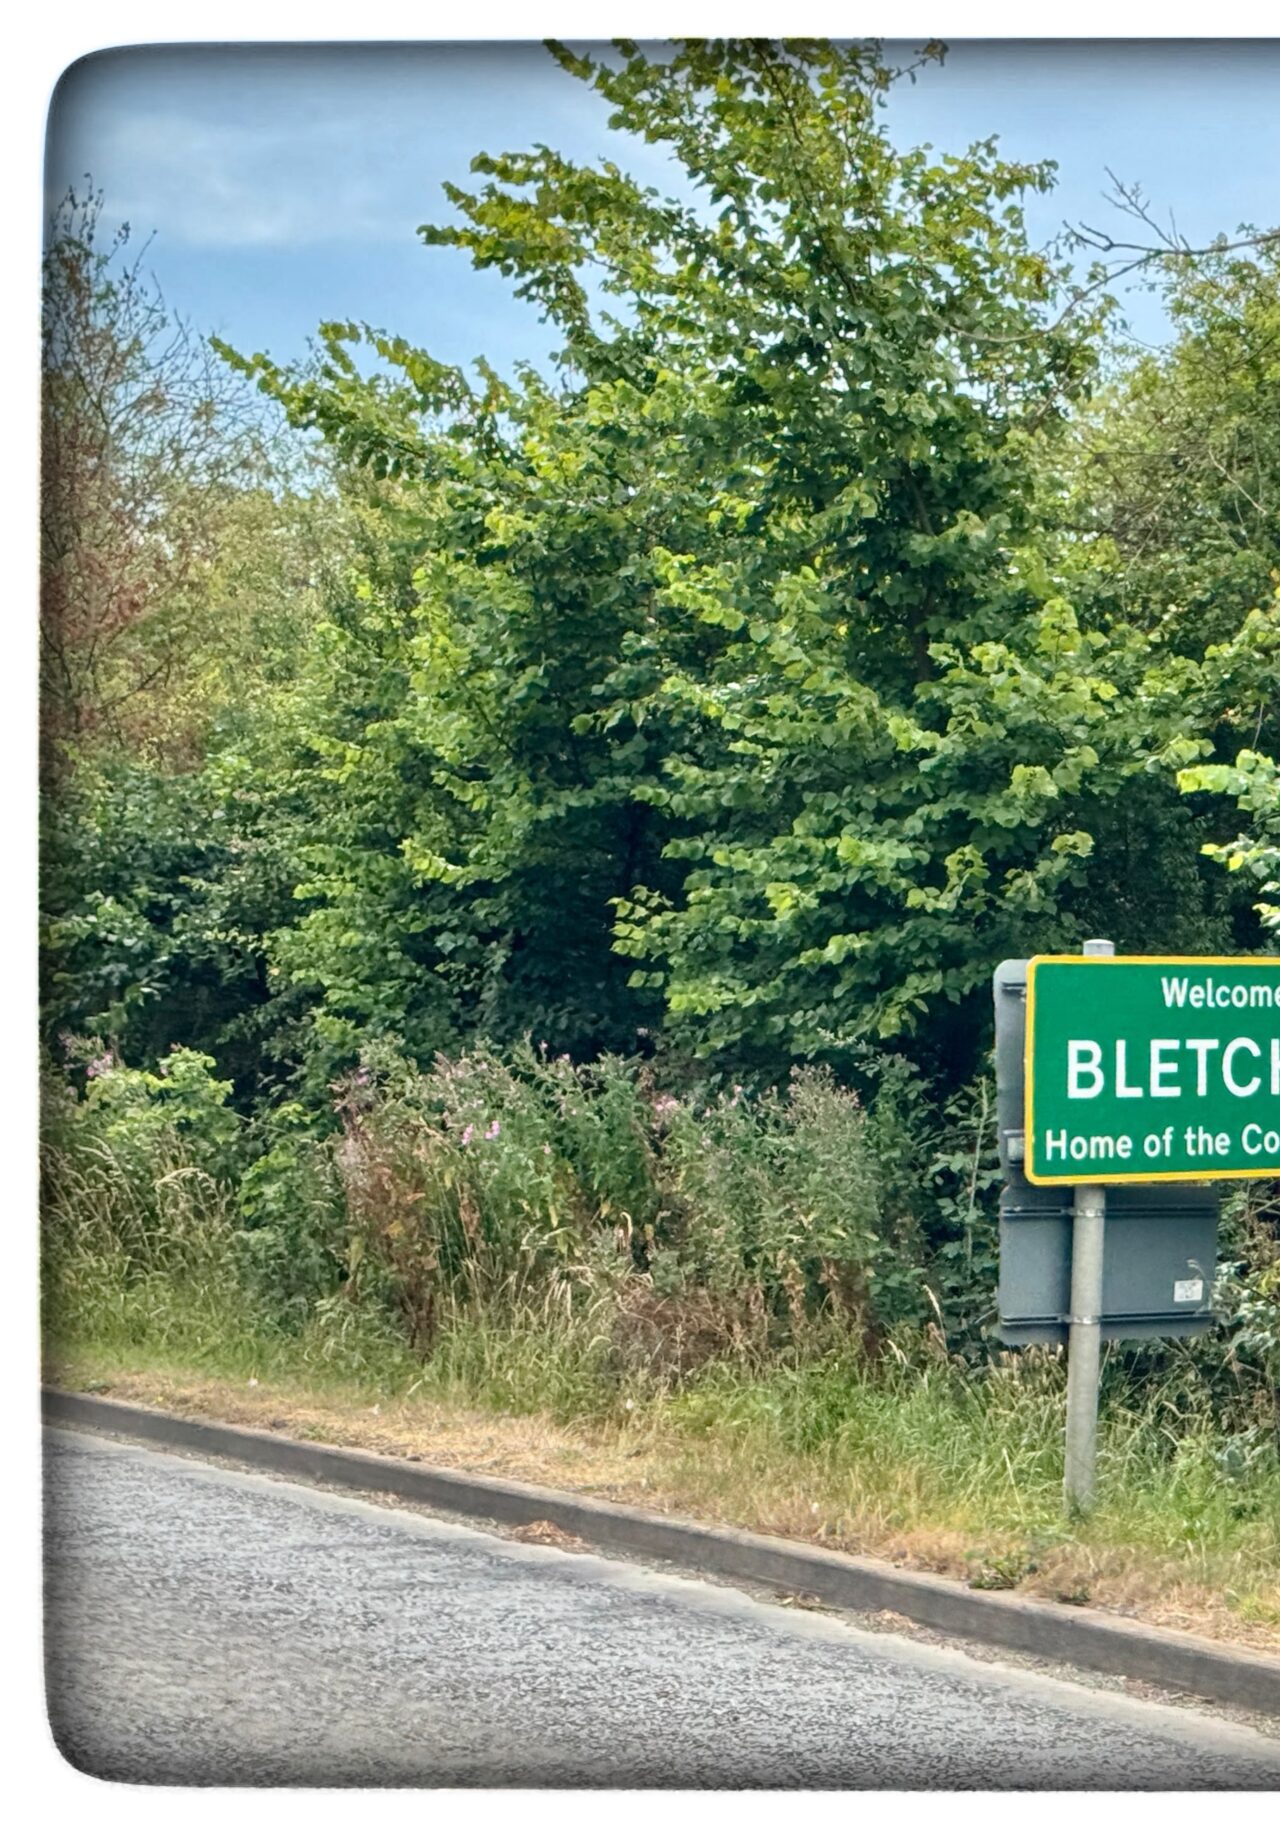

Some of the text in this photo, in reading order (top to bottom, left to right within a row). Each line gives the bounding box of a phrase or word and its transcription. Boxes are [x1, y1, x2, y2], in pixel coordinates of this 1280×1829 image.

[1045, 1129, 1133, 1161] Home
[1143, 1126, 1174, 1158] of
[1183, 1125, 1231, 1156] the
